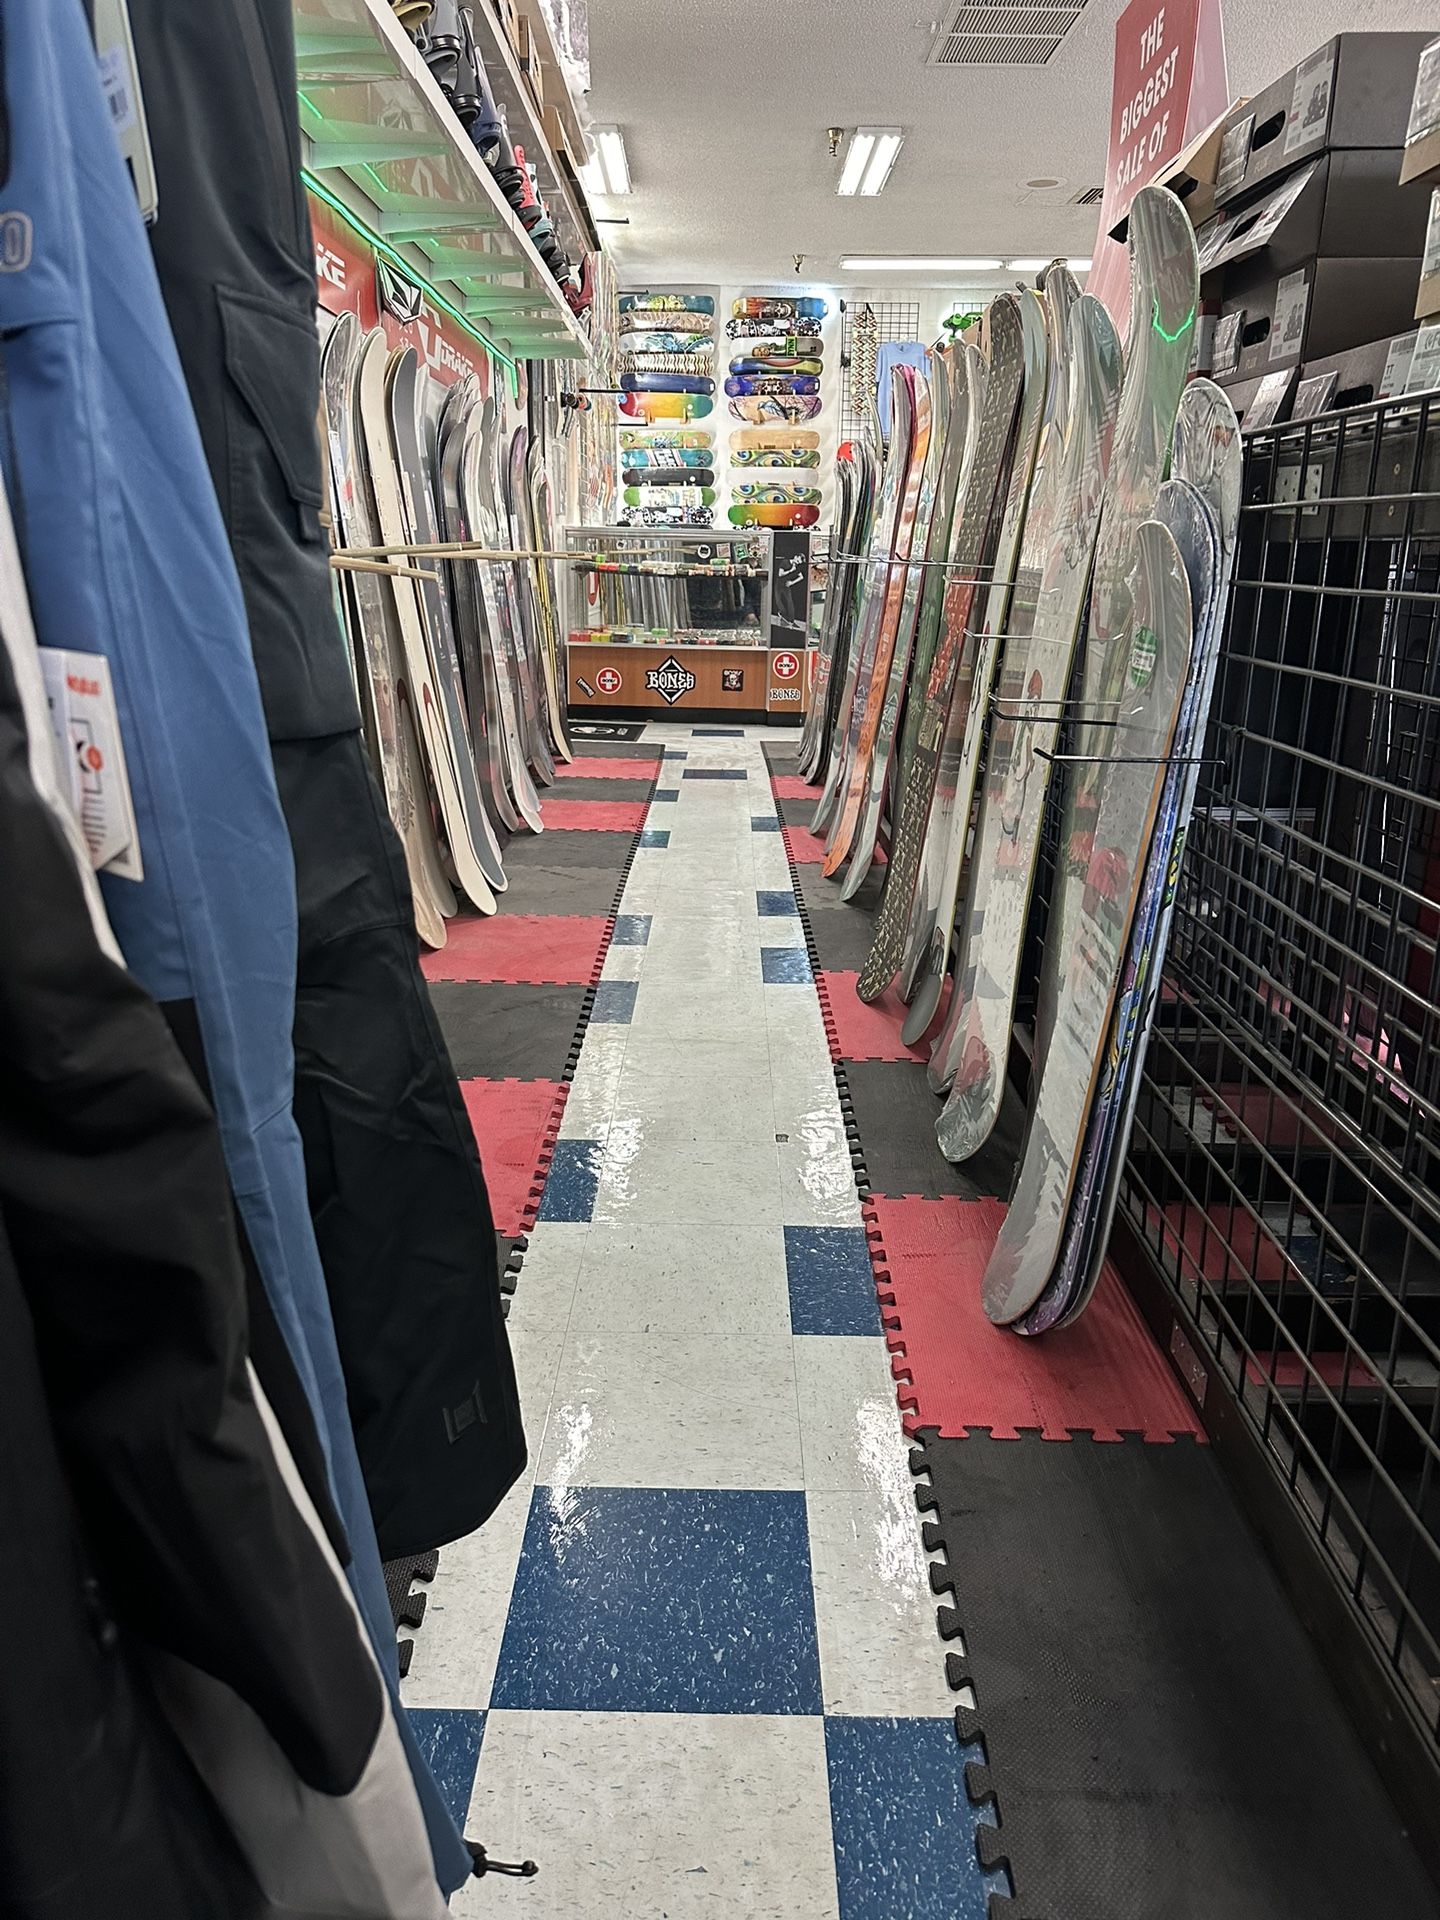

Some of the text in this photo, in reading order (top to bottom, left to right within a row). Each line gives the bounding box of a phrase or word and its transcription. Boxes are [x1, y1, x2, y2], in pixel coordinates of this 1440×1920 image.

[1140, 7, 1165, 71] THE
[1119, 45, 1179, 145] BIGGEST
[1115, 135, 1147, 194] SALE
[1148, 110, 1170, 162] OF
[316, 242, 346, 291] KE
[646, 671, 694, 689] BONES
[771, 688, 799, 699] BONES
